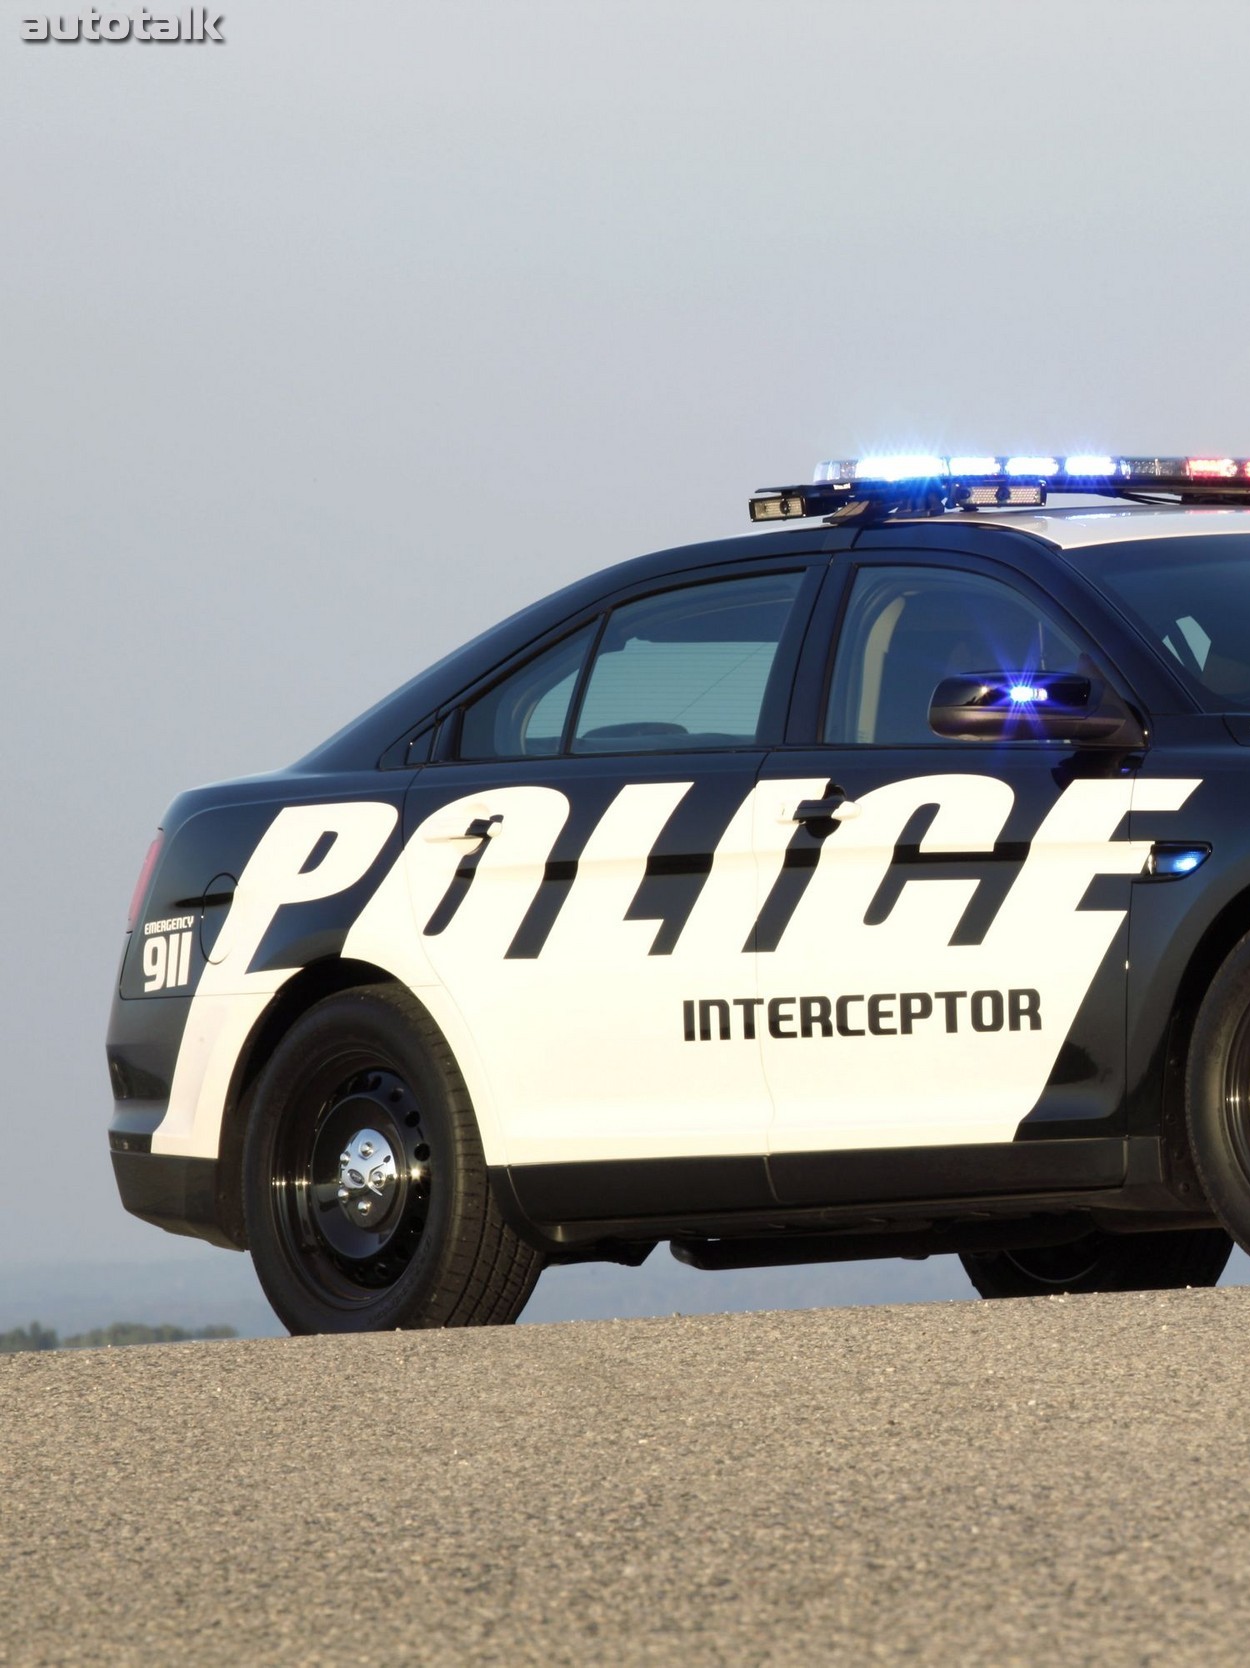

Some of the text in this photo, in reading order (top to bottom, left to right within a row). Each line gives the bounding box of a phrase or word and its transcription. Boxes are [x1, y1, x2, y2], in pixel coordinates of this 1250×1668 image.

[195, 773, 1204, 978] POLICE
[144, 915, 194, 935] EMERGENCY
[143, 931, 193, 993] 911
[682, 988, 1043, 1042] INTERCEPTOR
